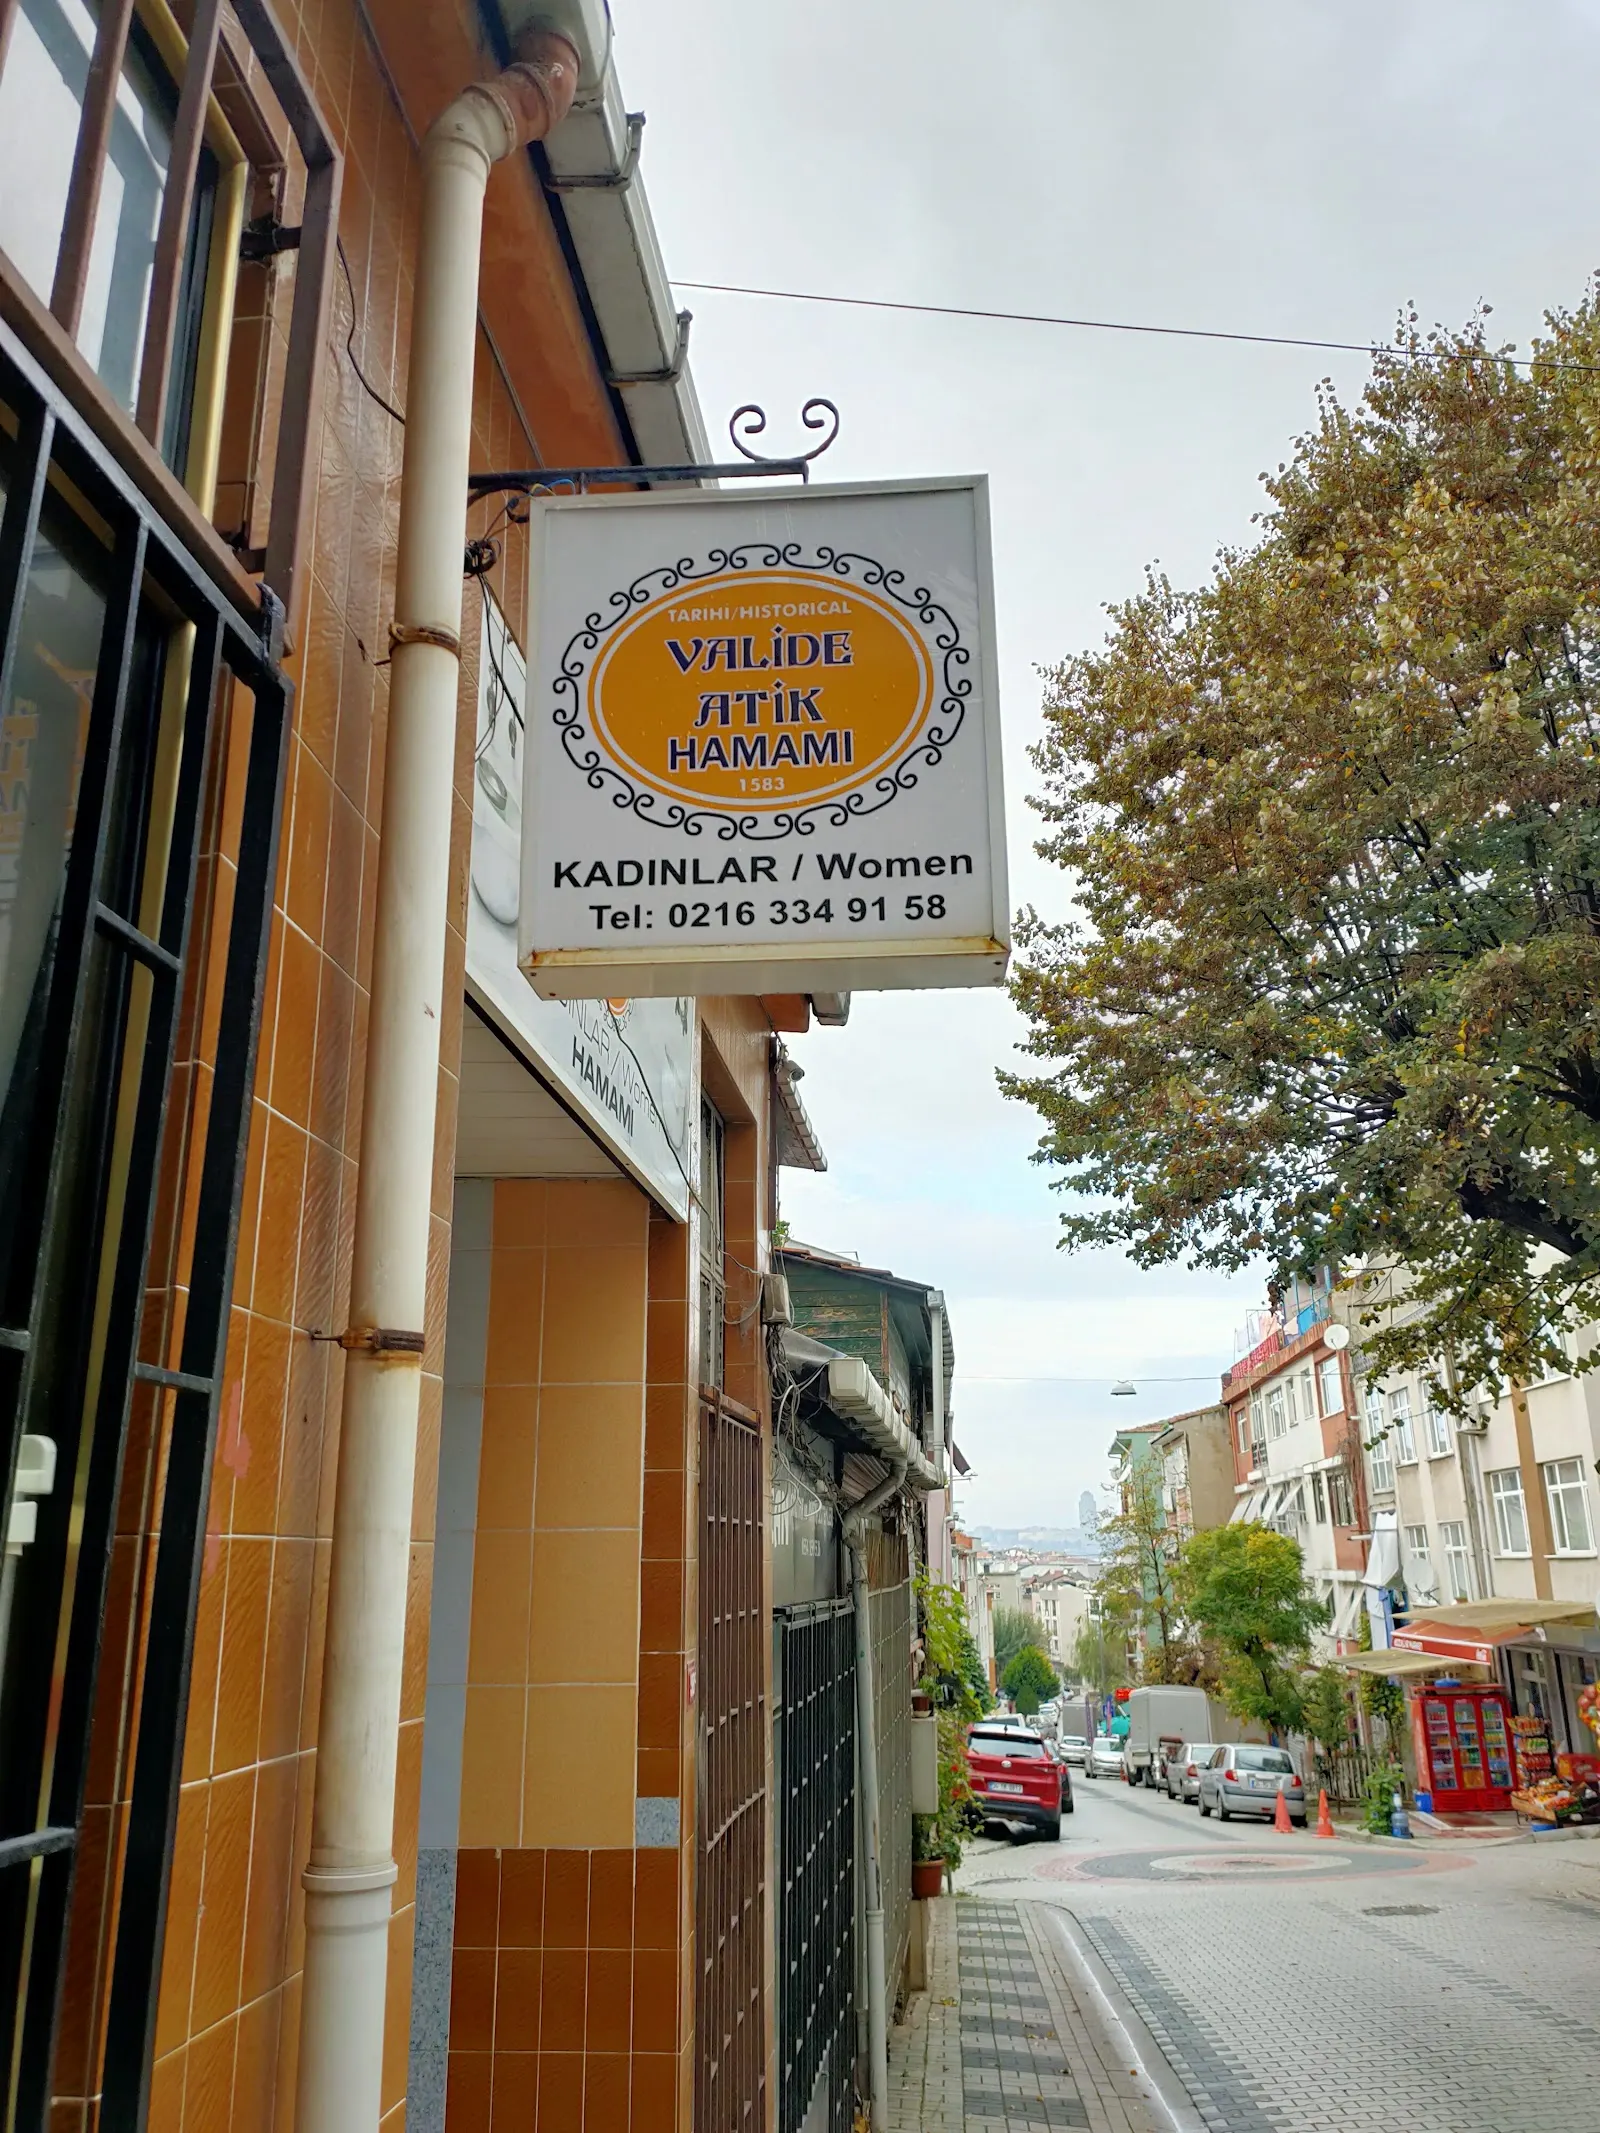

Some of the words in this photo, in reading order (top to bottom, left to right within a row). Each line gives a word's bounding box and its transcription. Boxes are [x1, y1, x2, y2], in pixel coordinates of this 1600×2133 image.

[664, 623, 854, 675] VALİDE
[693, 678, 826, 729] ATİK
[668, 729, 854, 773] HAMAMI
[739, 776, 785, 792] 1583
[553, 855, 778, 888] KADINLAR
[791, 854, 803, 882] /
[816, 852, 973, 881] Women
[589, 903, 654, 930] Tel:
[668, 900, 756, 929] 0216
[769, 898, 834, 925] 334
[847, 896, 887, 923] 91
[904, 893, 947, 921] 58
[571, 1033, 635, 1138] HAMAMI
